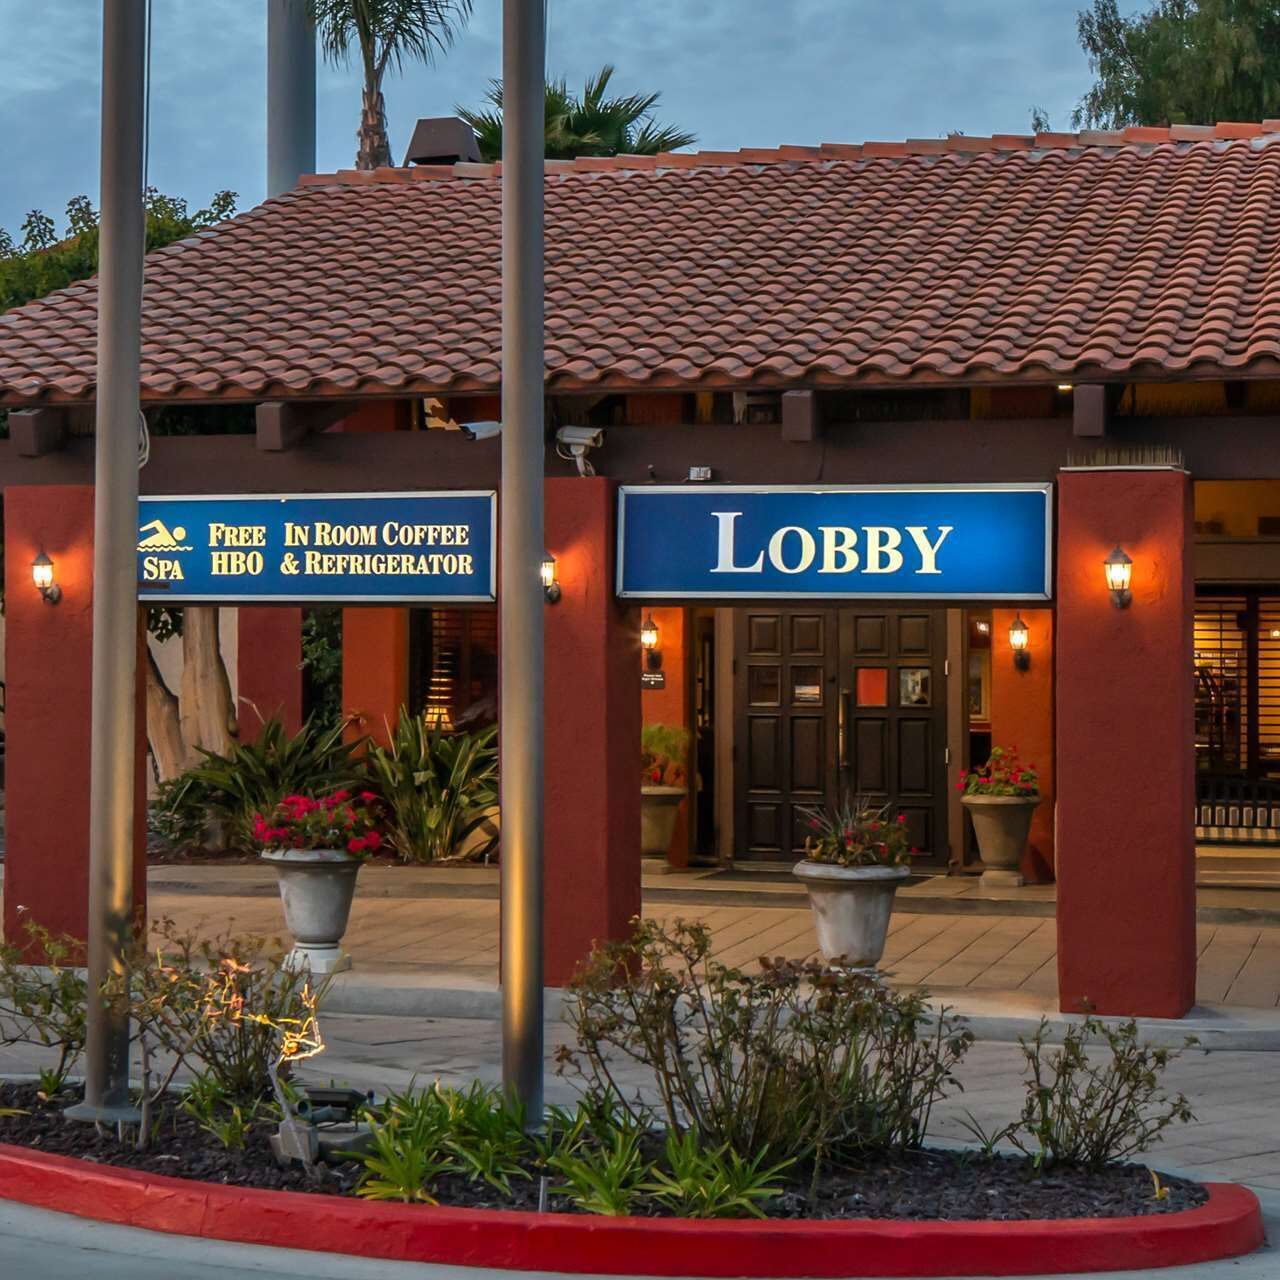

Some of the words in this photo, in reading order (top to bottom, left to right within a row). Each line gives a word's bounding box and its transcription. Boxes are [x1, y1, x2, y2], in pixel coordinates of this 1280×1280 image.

[208, 522, 267, 548] FREE
[283, 522, 310, 547] IN
[313, 522, 378, 547] ROOM
[382, 521, 470, 547] COFFEE
[709, 511, 954, 575] LOBBY
[143, 556, 185, 581] SPA
[210, 550, 264, 576] HBO
[279, 552, 300, 576] &
[304, 550, 474, 576] REFRIGERATOR
